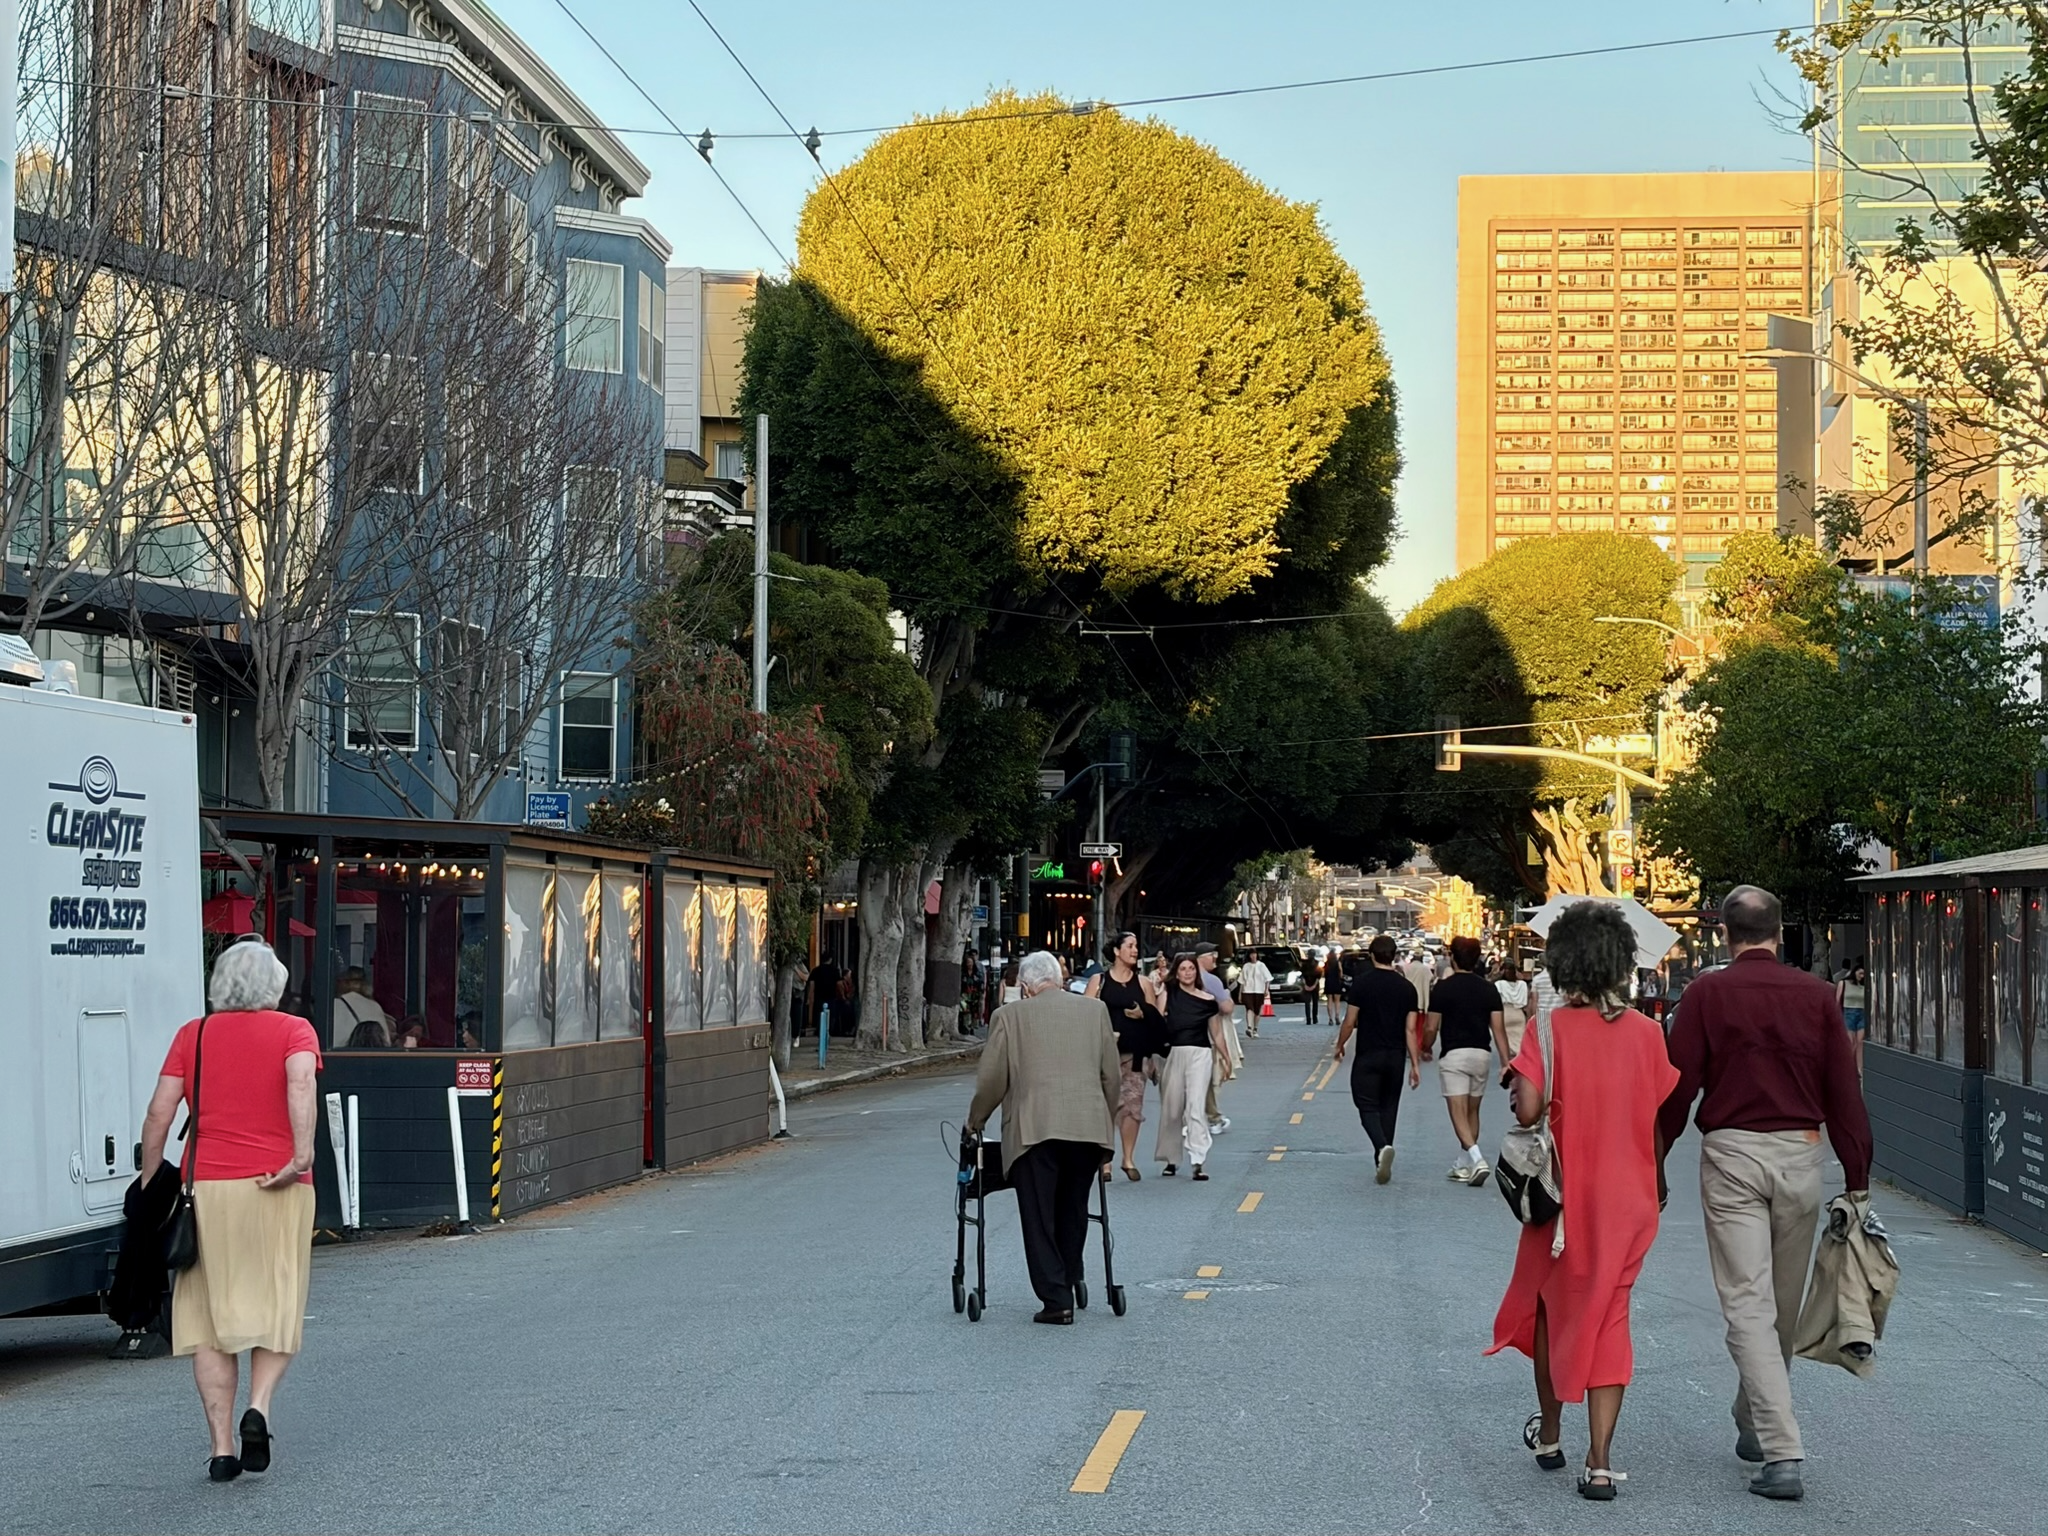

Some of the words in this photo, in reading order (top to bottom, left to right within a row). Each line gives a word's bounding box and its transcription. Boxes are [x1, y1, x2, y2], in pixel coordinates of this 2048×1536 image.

[530, 795, 545, 805] Pay
[546, 795, 557, 805] by
[530, 803, 559, 811] License
[1097, 846, 1109, 854] WAY
[82, 856, 142, 893] SERVICES
[49, 896, 147, 931] 866.679.3373
